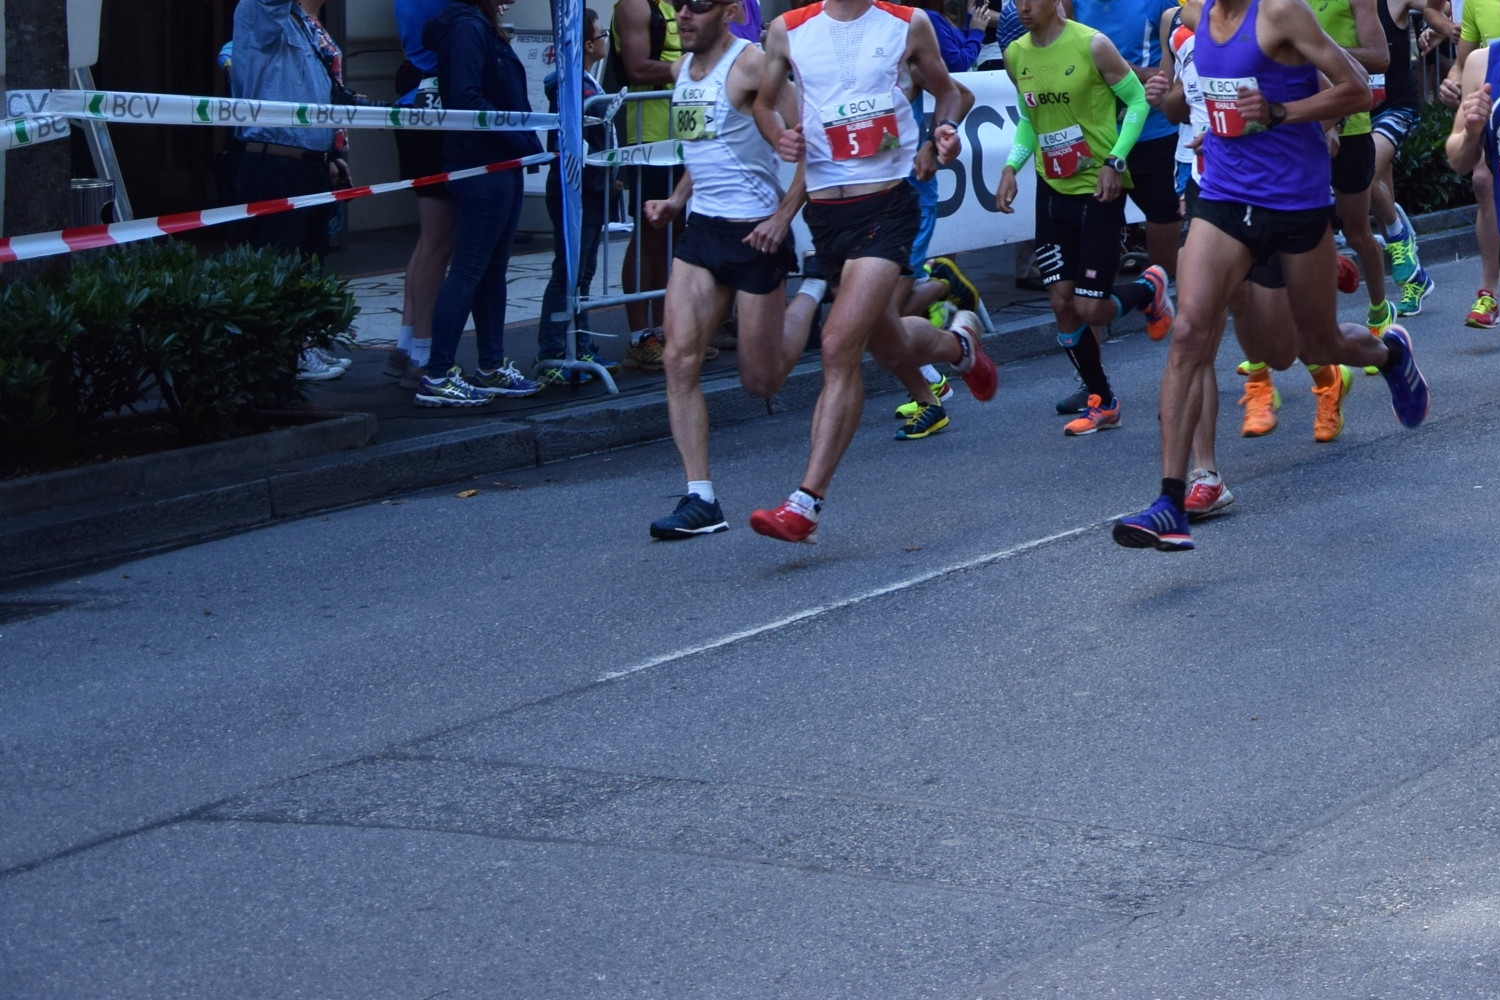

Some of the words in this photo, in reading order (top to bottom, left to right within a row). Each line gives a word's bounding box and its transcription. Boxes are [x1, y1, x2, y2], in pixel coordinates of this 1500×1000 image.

[688, 88, 706, 101] BCV
[1216, 81, 1240, 93] BCV
[849, 99, 876, 115] BCV
[1038, 92, 1070, 105] BCVS
[112, 95, 160, 120] BCV
[218, 101, 263, 123] BCV
[316, 106, 358, 125] BCV
[408, 110, 448, 127] BCV
[493, 111, 531, 128] BCV
[677, 110, 697, 132] 806
[1212, 110, 1228, 134] 11
[848, 133, 860, 155] 5
[1047, 131, 1067, 144] BCV
[620, 145, 653, 165] BCV
[1053, 158, 1062, 175] 4
